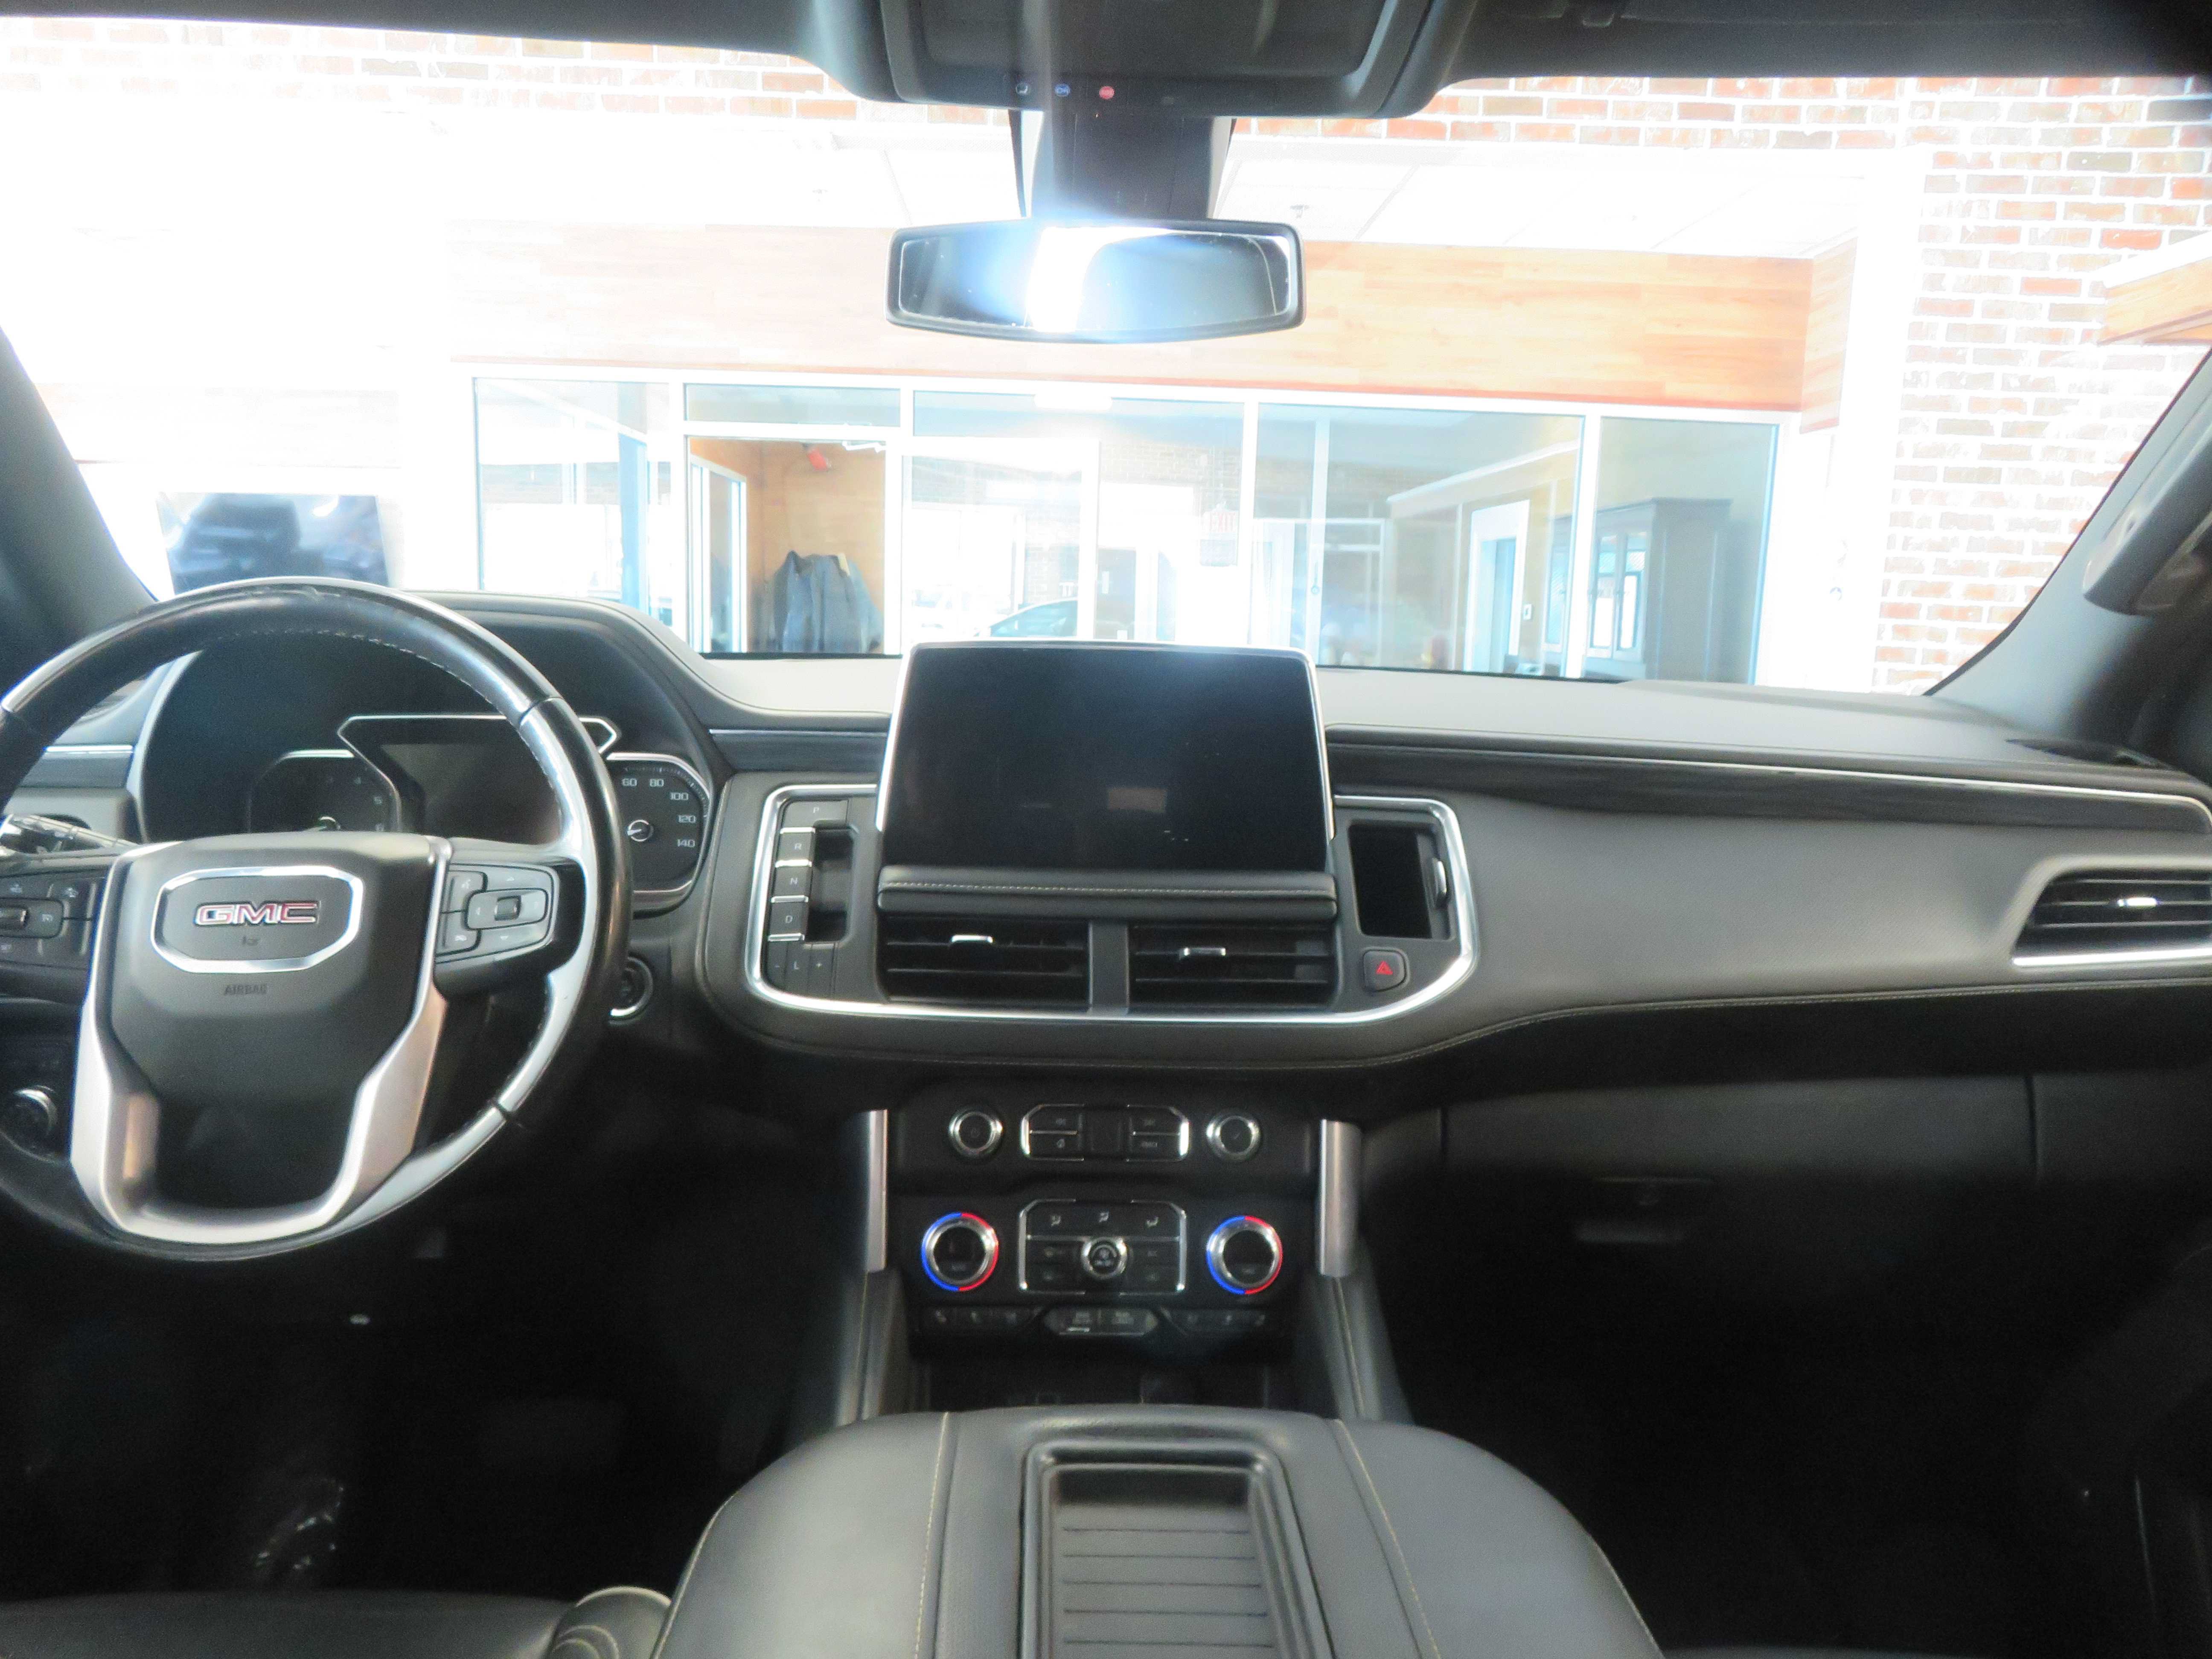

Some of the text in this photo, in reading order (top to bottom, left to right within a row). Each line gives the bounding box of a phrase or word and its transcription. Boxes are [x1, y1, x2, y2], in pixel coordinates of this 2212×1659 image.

[649, 778, 664, 787] 80
[670, 792, 689, 800] 100
[678, 815, 696, 823] 120
[677, 839, 696, 847] 140
[195, 903, 317, 925] GMC
[785, 915, 793, 923] D
[224, 984, 267, 995] AIRBAG
